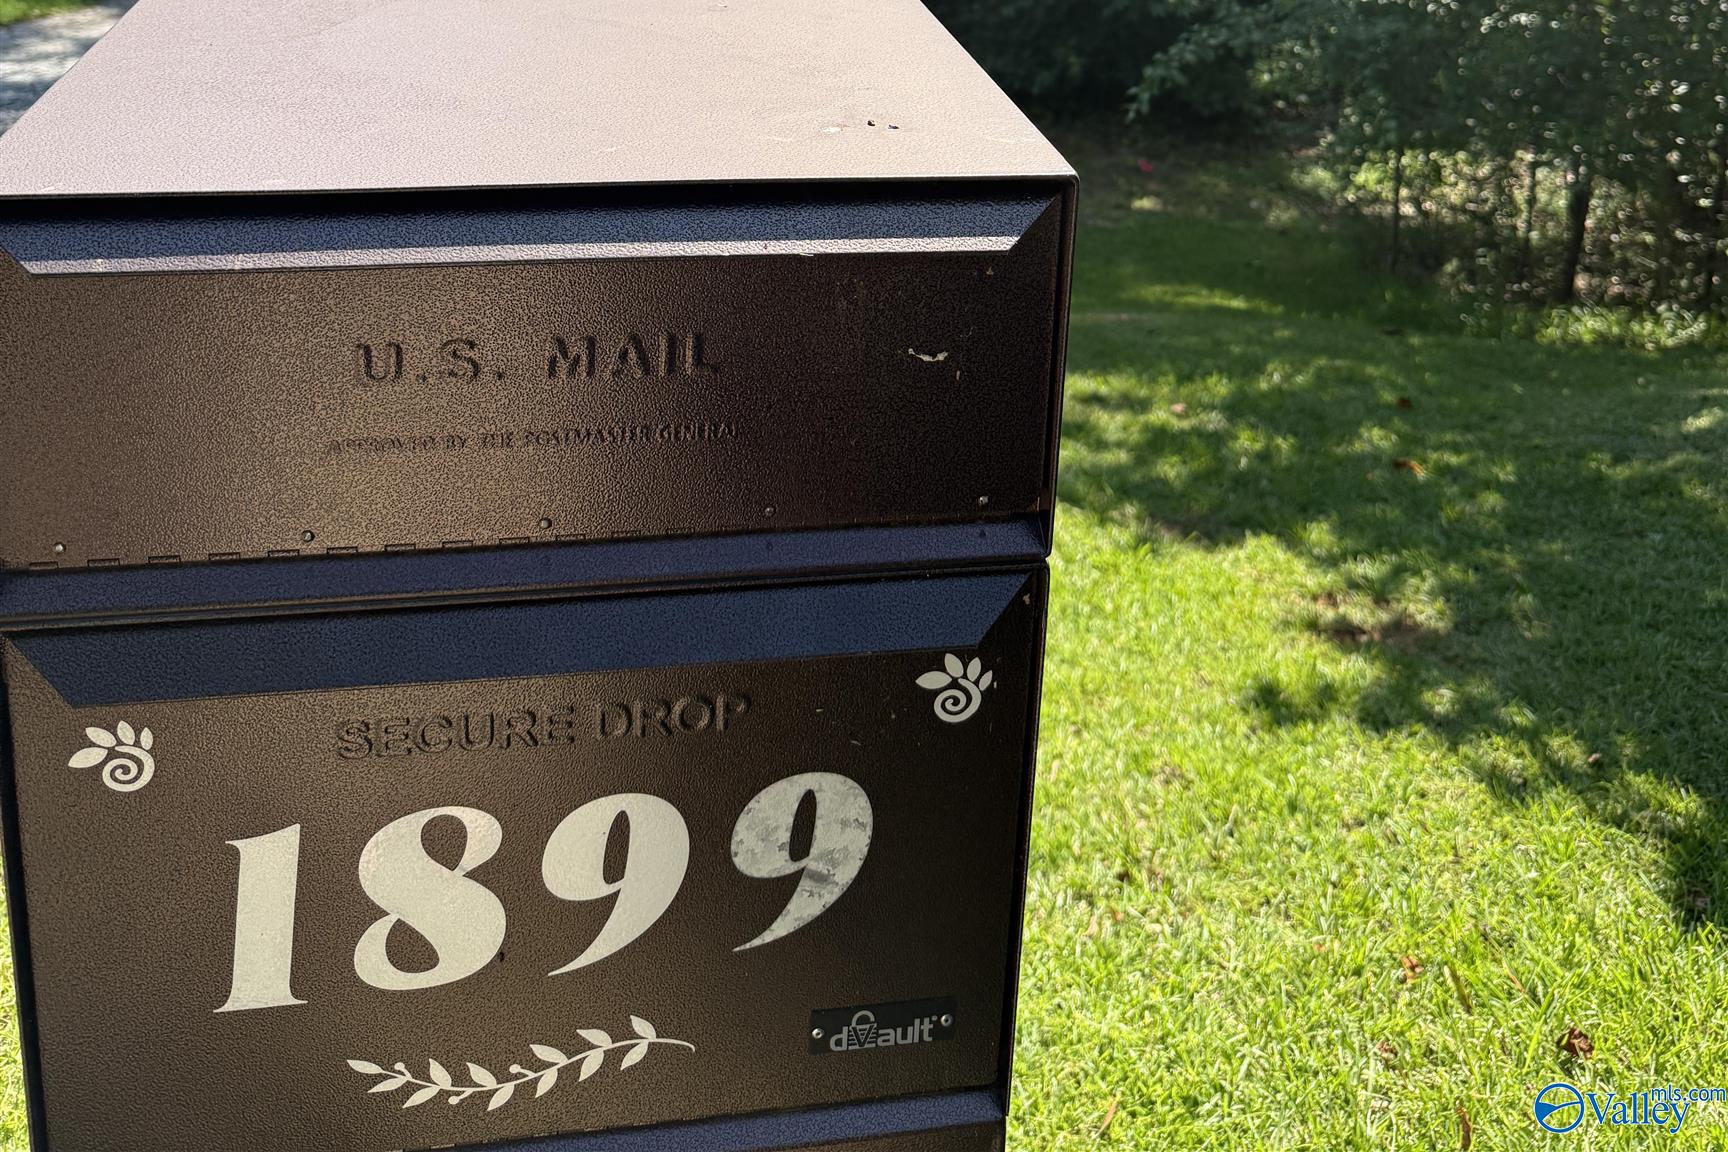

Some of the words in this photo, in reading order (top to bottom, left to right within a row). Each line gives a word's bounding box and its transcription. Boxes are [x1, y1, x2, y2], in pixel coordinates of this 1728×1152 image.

[358, 338, 504, 382] U.S.
[546, 330, 718, 379] MAIL
[335, 705, 576, 760] SECURE
[600, 692, 752, 738] DROP
[213, 771, 874, 1014] 1899
